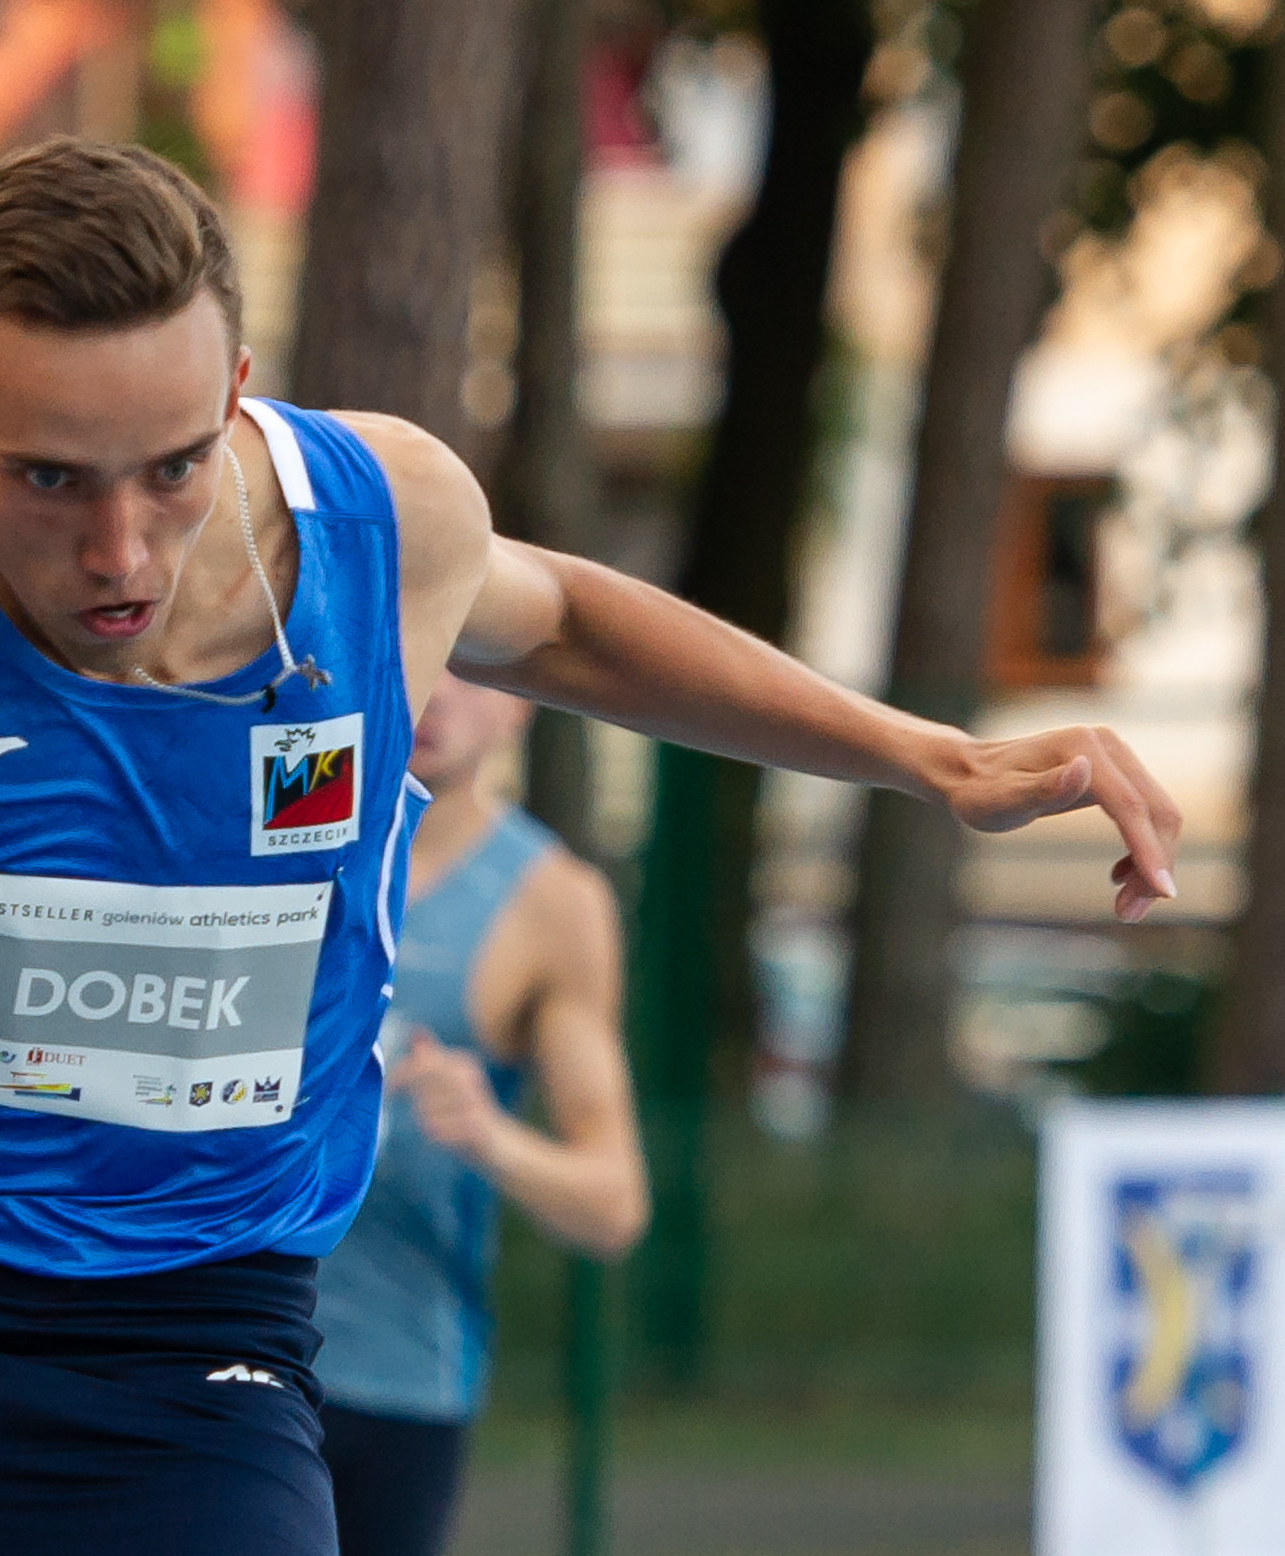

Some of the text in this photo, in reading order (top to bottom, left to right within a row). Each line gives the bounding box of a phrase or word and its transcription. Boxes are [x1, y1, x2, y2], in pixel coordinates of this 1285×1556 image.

[189, 911, 271, 927] athletics
[276, 906, 318, 927] park
[14, 967, 250, 1031] DOBEK
